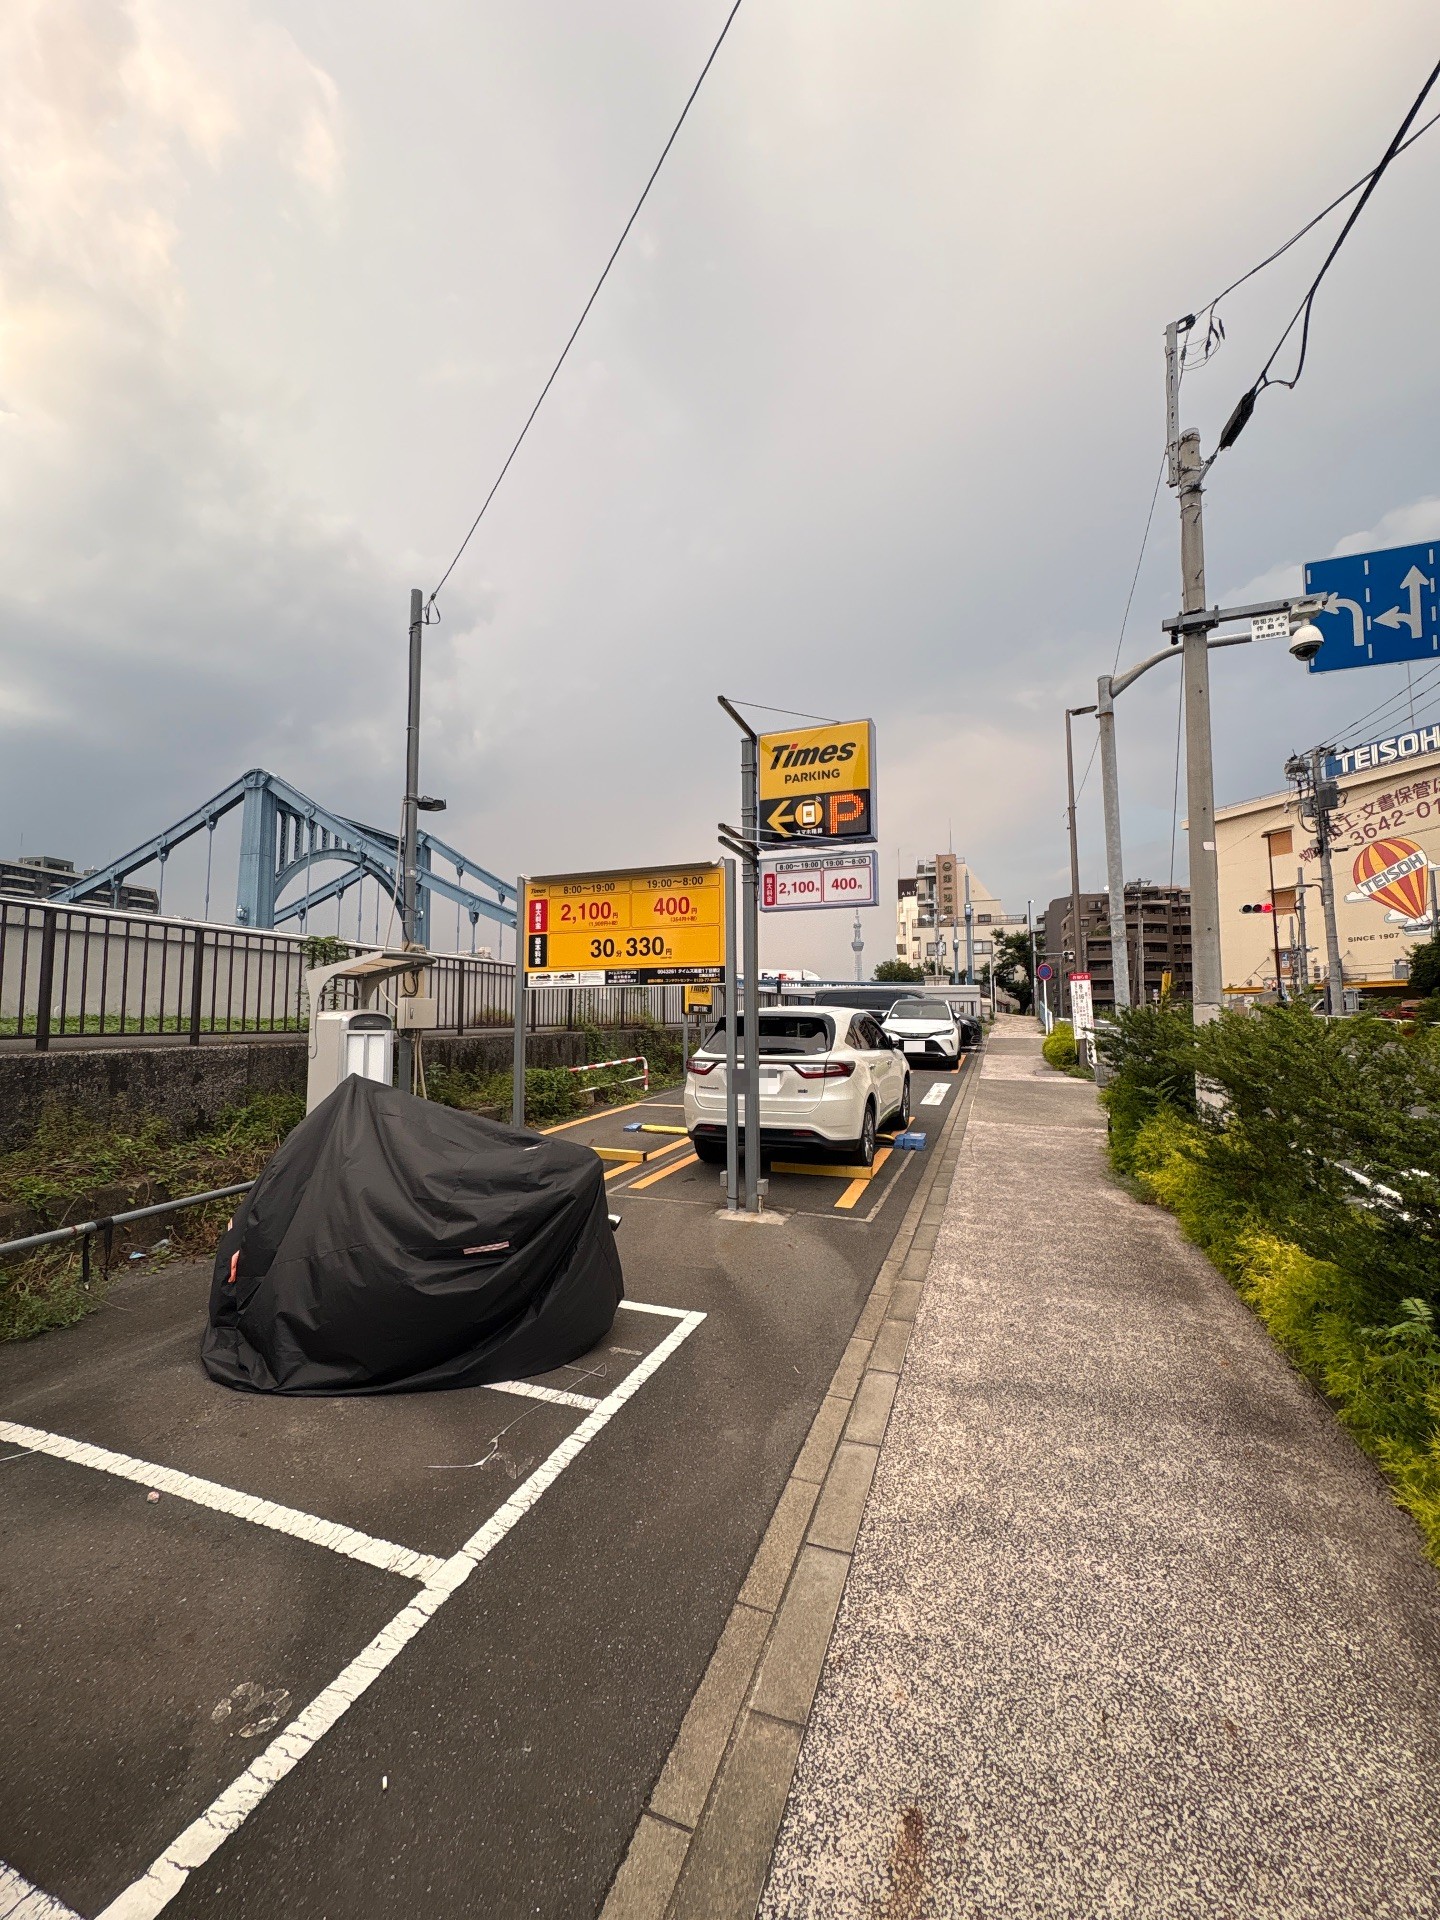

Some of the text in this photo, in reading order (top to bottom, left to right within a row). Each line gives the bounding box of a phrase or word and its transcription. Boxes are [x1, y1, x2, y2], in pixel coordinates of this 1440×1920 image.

[770, 742, 856, 770] Times
[1336, 725, 1440, 772] TEISOH
[785, 768, 840, 784] PARKING
[829, 794, 864, 834] P
[1299, 777, 1440, 862] 物加工・文書保管
[1360, 853, 1424, 894] TEISOH
[560, 901, 619, 924] 2,100円
[653, 896, 698, 916] 400円
[590, 936, 673, 959] 30分 330円
[1348, 931, 1400, 943] SINCE 1907
